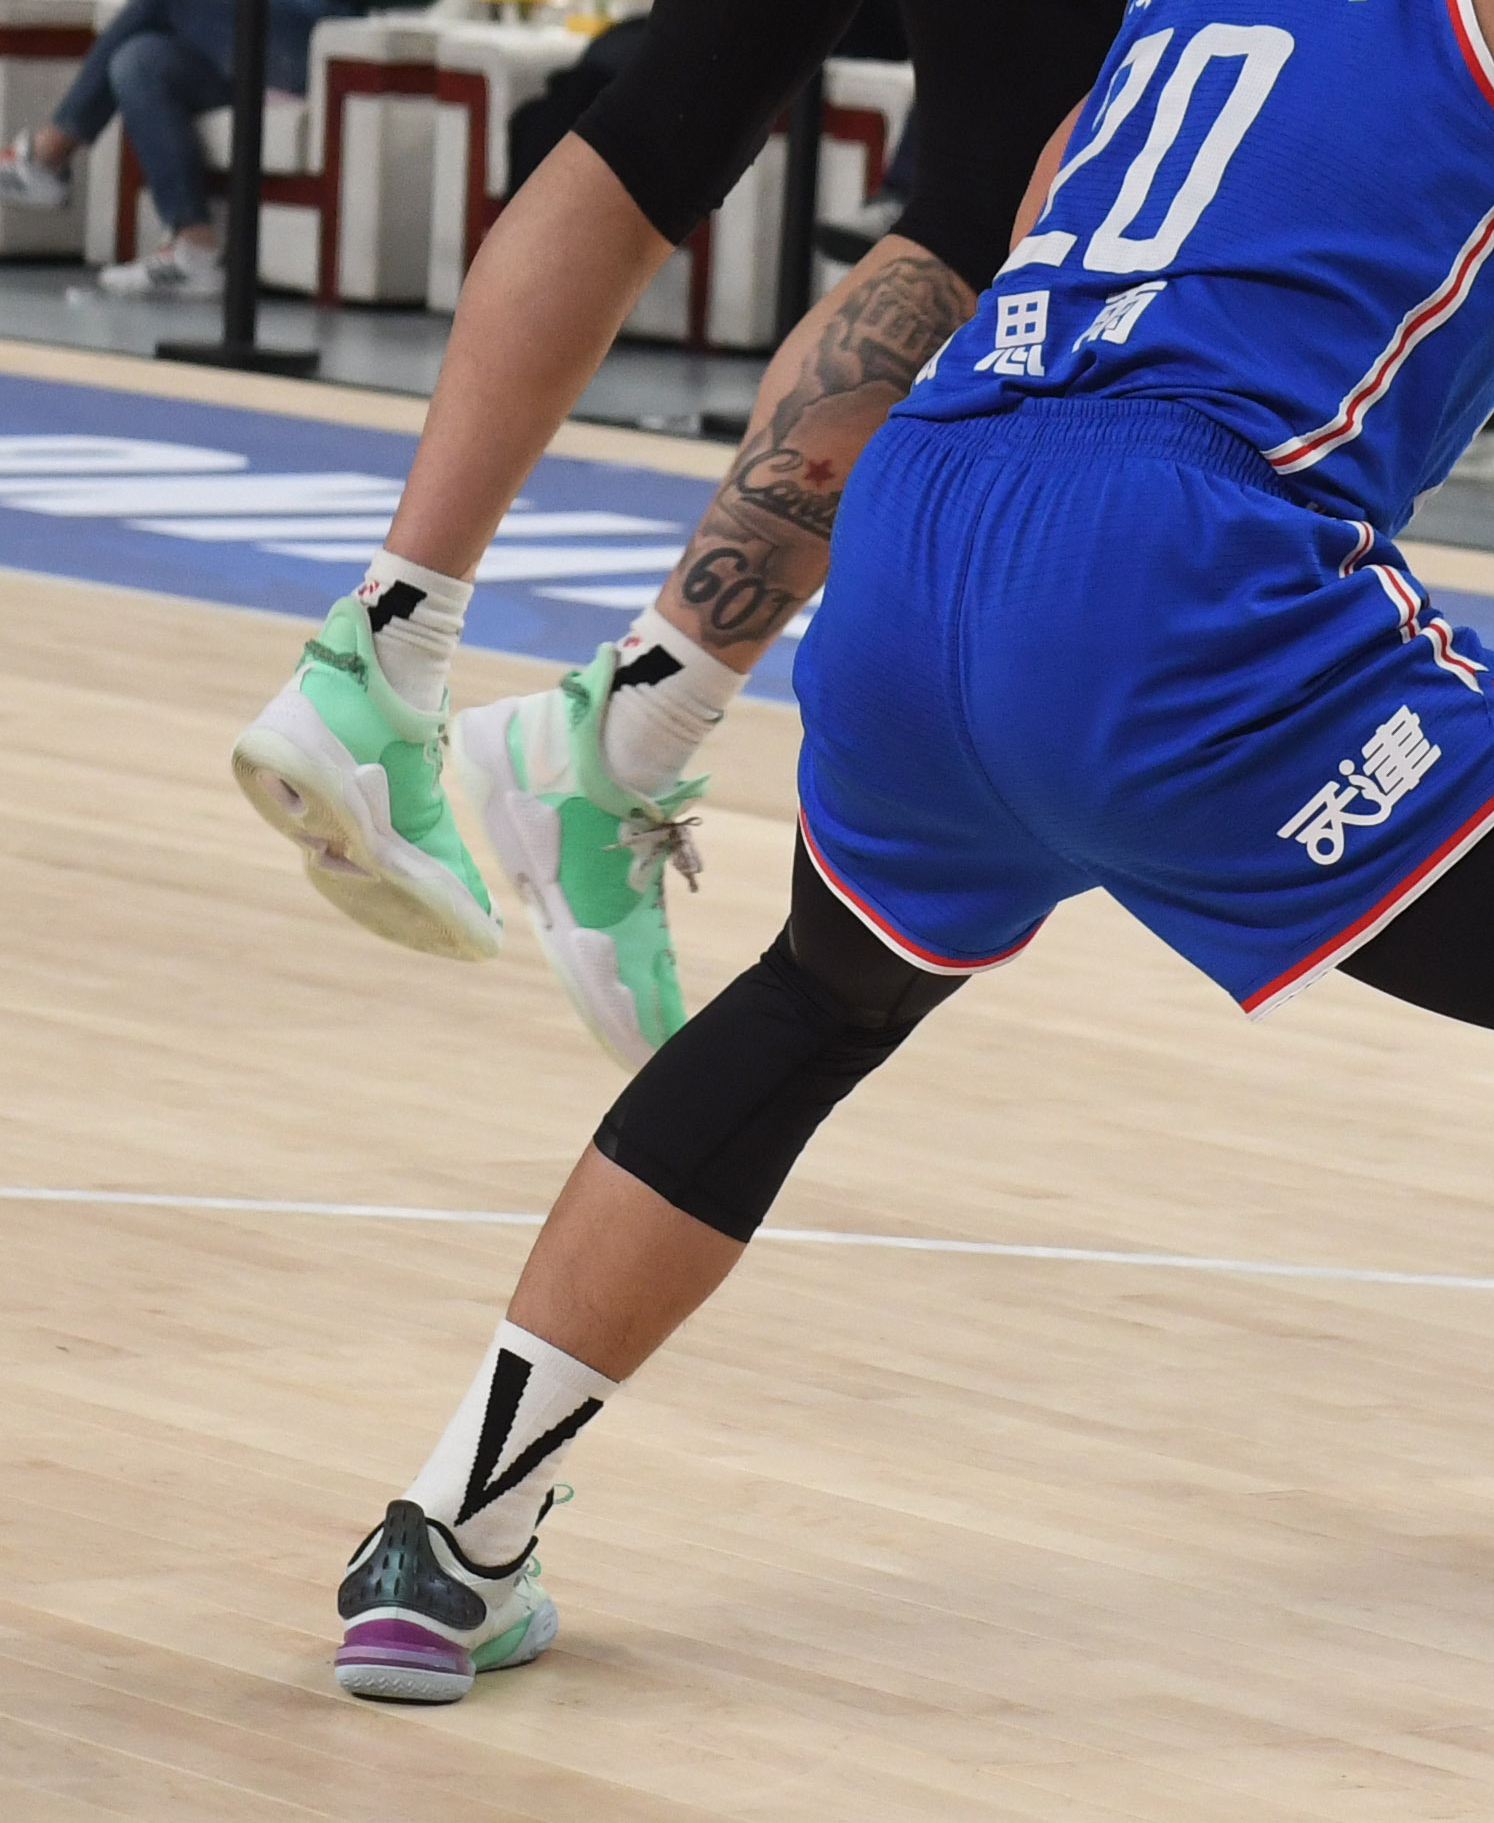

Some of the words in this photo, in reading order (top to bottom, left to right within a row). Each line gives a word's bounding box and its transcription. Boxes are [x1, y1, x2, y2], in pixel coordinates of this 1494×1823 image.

[996, 23, 1294, 281] 20
[915, 281, 1168, 386] 思雨
[1277, 705, 1442, 865] 天津
